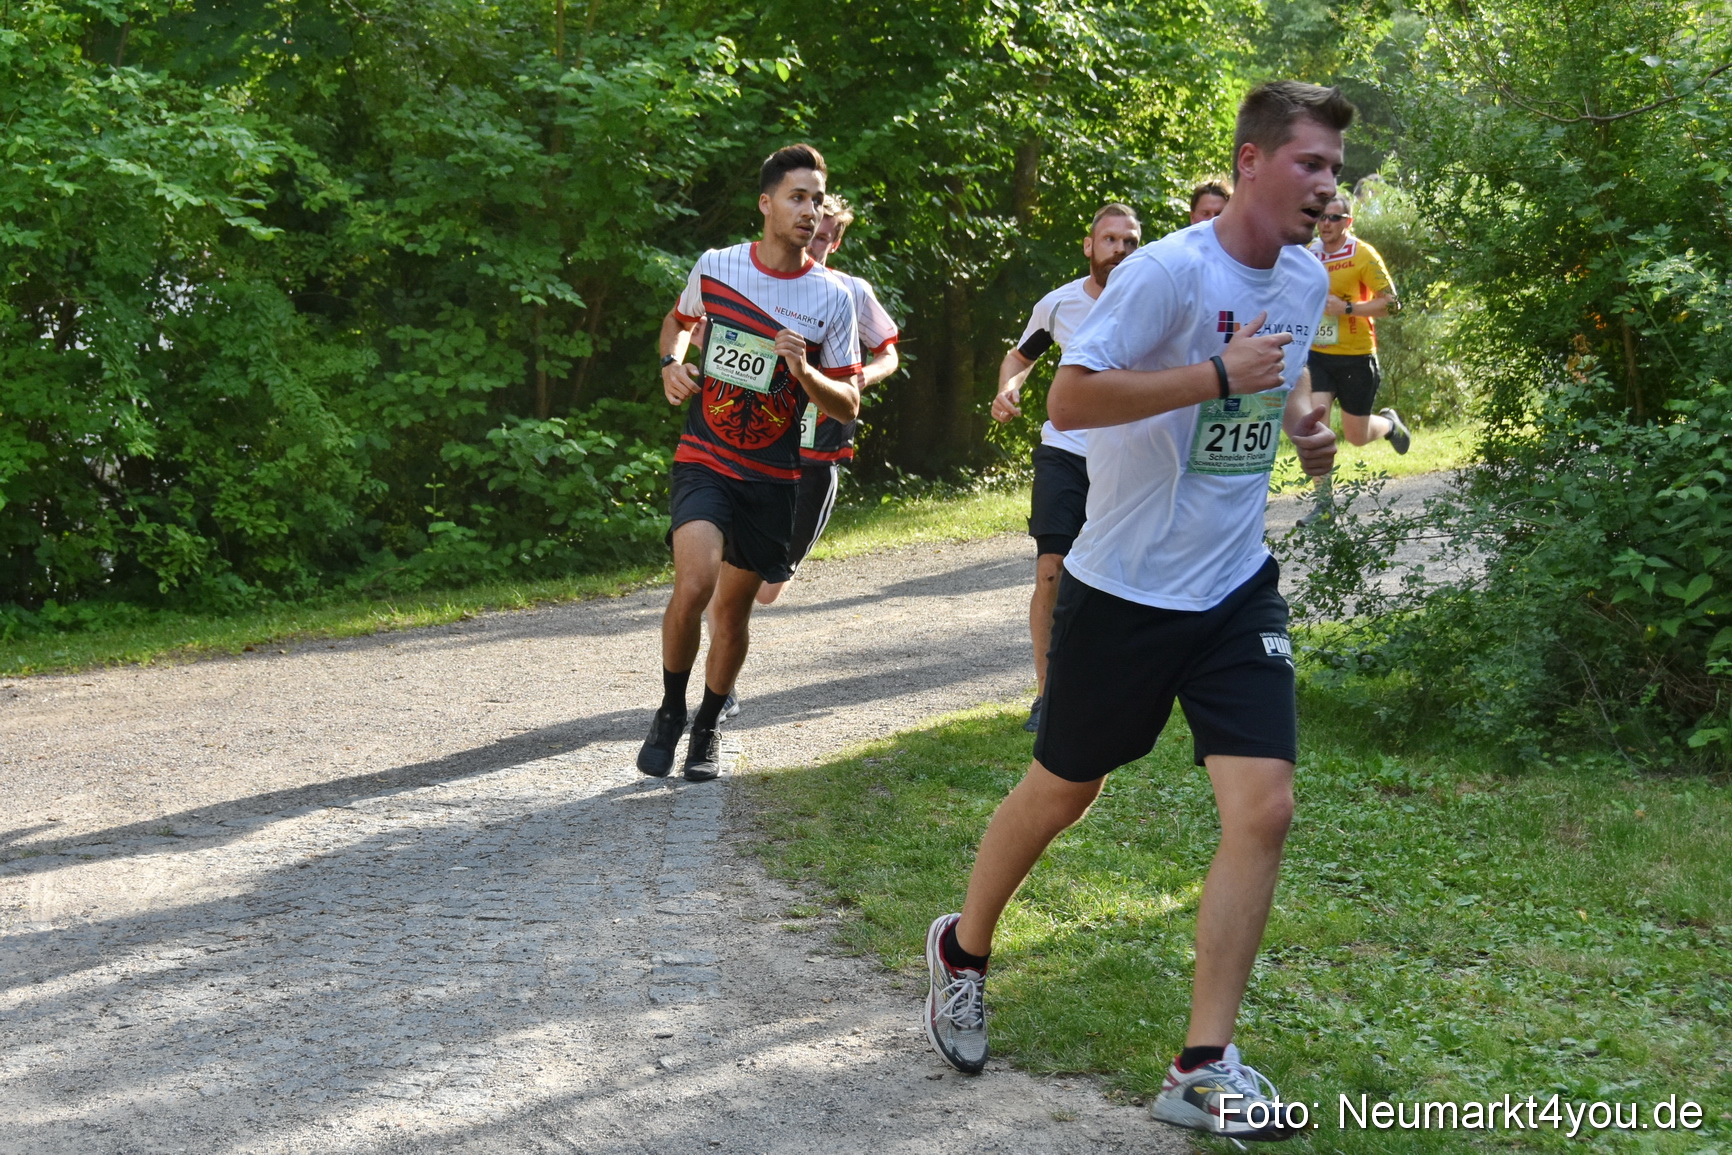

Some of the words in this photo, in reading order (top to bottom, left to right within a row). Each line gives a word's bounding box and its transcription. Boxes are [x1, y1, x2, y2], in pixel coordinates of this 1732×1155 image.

[775, 306, 817, 325] NEUMARKT
[1243, 323, 1308, 336] HWARZ
[713, 345, 765, 376] 2260
[716, 364, 734, 374] Schmid
[735, 370, 757, 381] Manfred
[1205, 422, 1272, 452] 2150
[1208, 453, 1245, 461] Schneider
